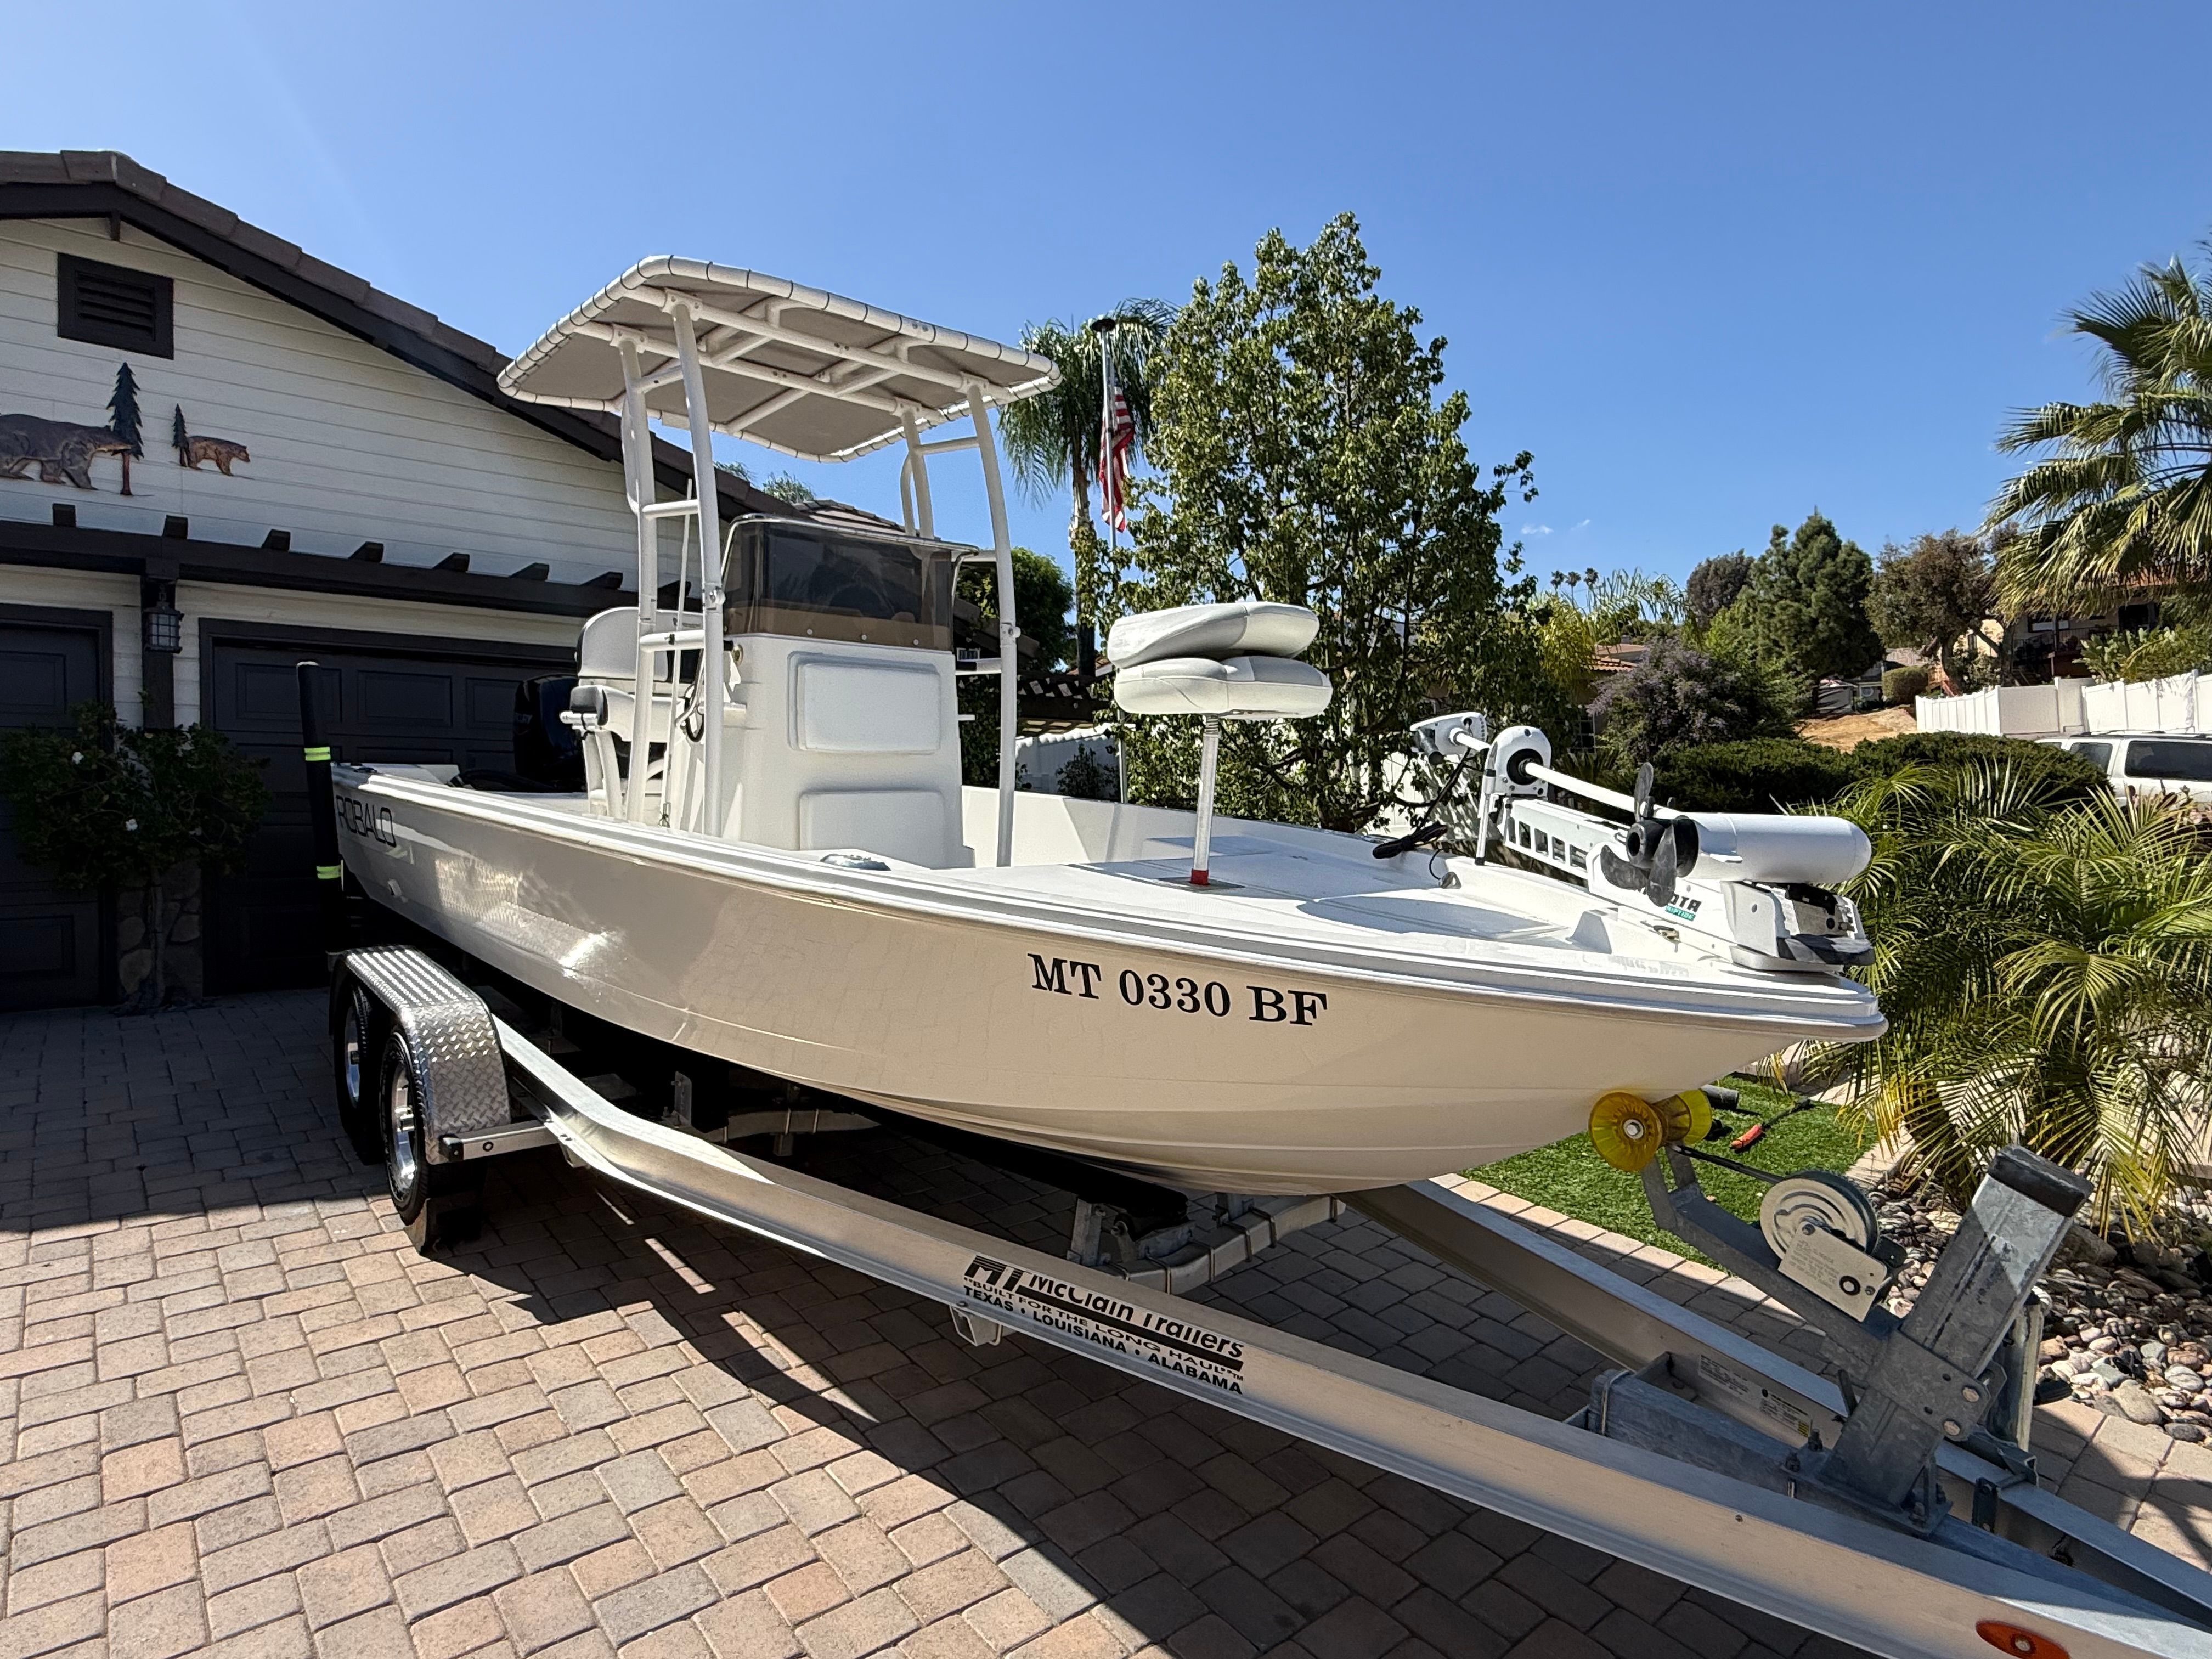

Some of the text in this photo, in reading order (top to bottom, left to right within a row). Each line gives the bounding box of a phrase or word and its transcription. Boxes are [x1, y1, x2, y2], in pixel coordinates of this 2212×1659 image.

[336, 795, 397, 848] ROBALO
[1027, 953, 1328, 1026] MT 0330 BF
[1019, 1297, 1052, 1314] FOR
[1056, 1310, 1088, 1327] THE
[1096, 1324, 1161, 1352] LONG
[1029, 1274, 1134, 1321] McClain
[963, 1285, 1243, 1395] TEXAS LOUISIANA ALABAMA
